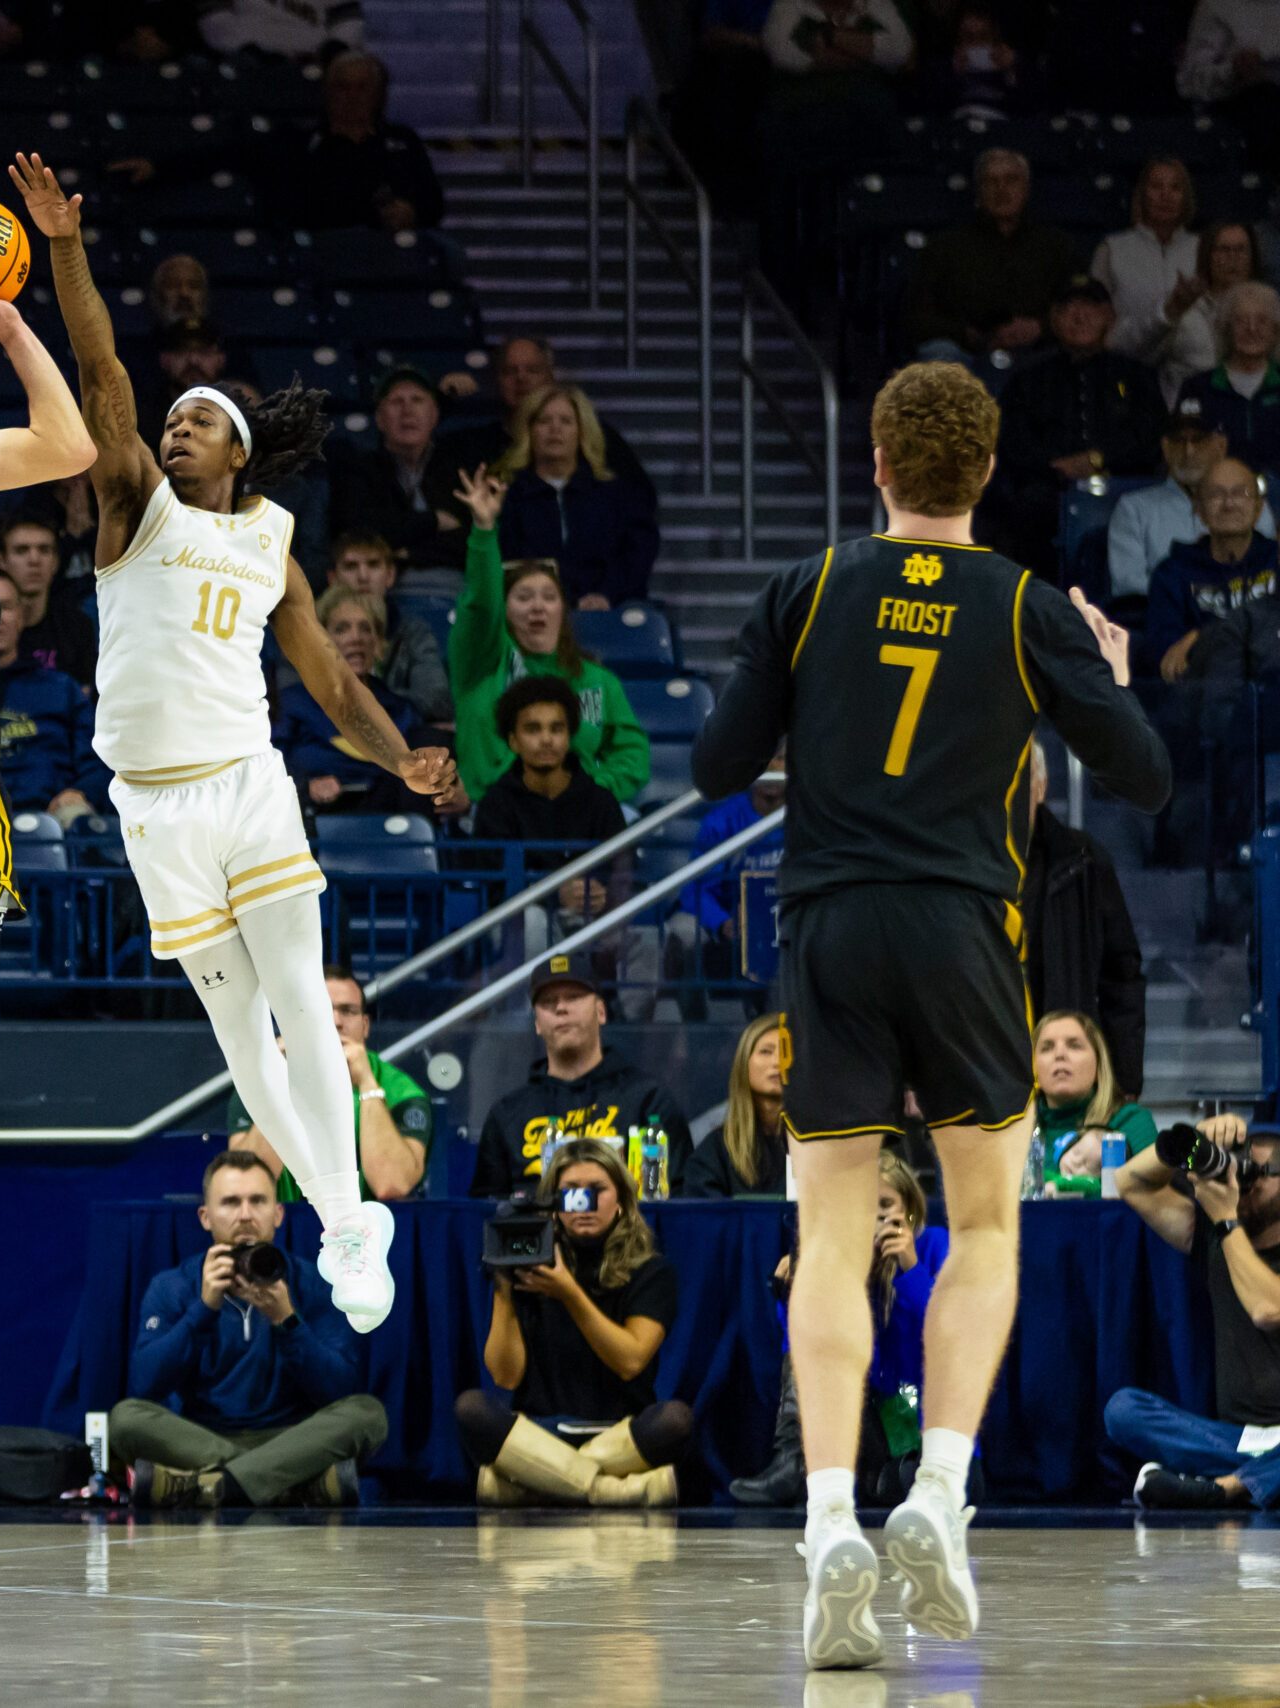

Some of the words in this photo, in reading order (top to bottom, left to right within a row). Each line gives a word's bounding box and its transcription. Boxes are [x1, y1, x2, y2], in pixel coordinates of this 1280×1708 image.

[161, 544, 276, 589] Mastodons
[191, 580, 242, 641] 10
[876, 597, 959, 637] FROST
[879, 644, 941, 777] 7
[564, 1188, 591, 1212] 16
